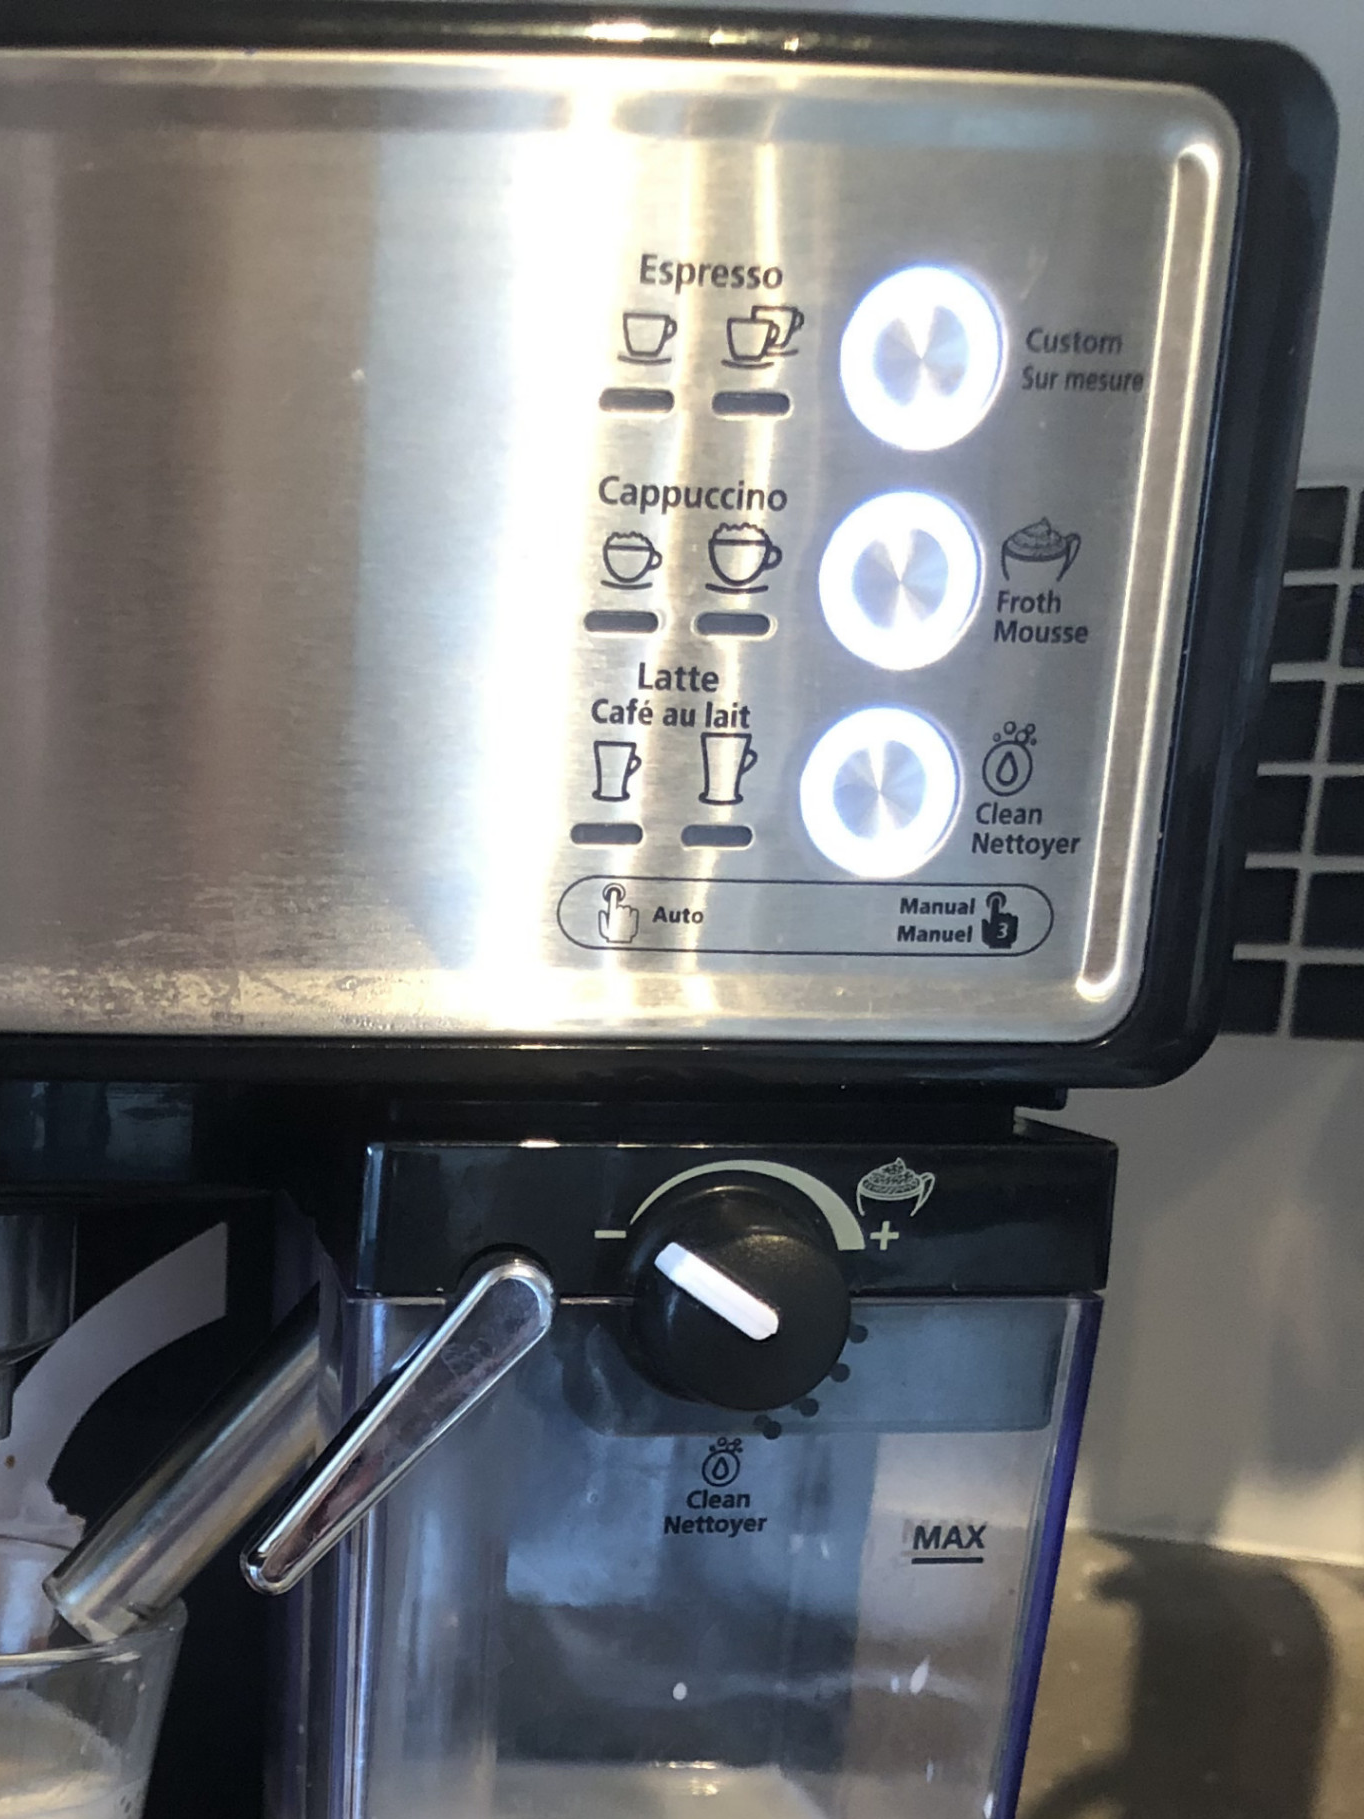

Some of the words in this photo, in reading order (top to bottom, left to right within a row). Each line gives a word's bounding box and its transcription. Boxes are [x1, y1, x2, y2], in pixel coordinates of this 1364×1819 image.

[639, 253, 783, 292] Espresso
[1026, 327, 1123, 354] Custom
[1021, 366, 1058, 391] Sur
[1064, 369, 1144, 392] mesure
[598, 474, 788, 513] Cappuccino
[997, 590, 1061, 614] Froth
[993, 620, 1089, 645] Mousse
[638, 662, 719, 693] Latte
[591, 699, 654, 726] Café
[662, 707, 696, 728] au
[704, 701, 750, 730] lait
[976, 802, 1042, 826] Clean
[971, 833, 1081, 857] Nettoyer
[652, 904, 704, 925] Auto
[900, 897, 976, 915] Manual
[897, 925, 973, 943] Manuel
[996, 922, 1009, 939] 3
[686, 1489, 751, 1511] Clean
[663, 1513, 768, 1538] Nettoyer
[913, 1524, 987, 1550] MAX
